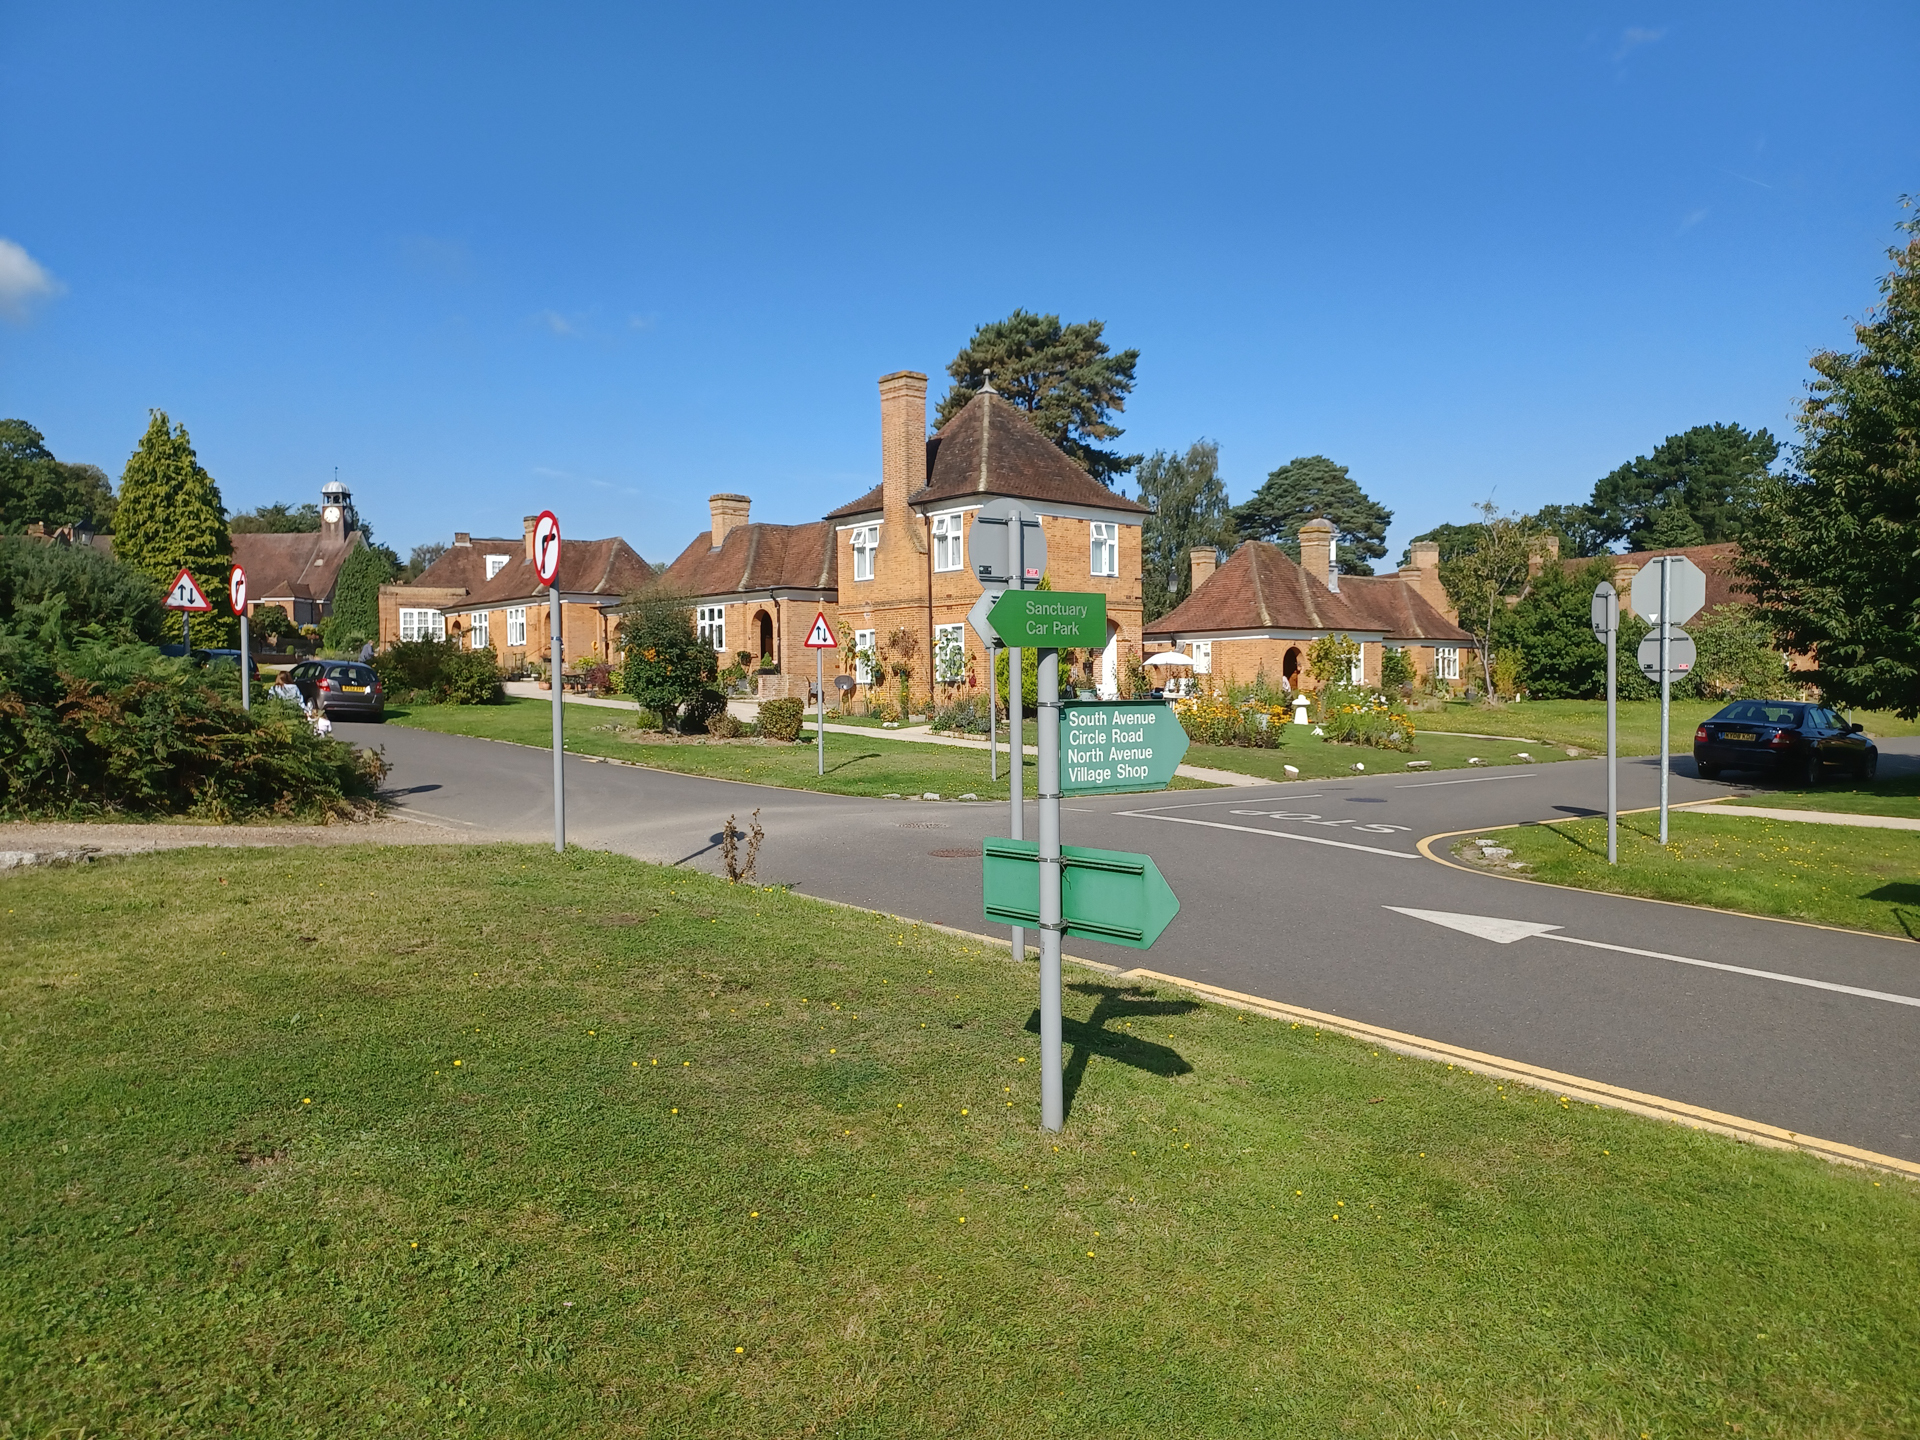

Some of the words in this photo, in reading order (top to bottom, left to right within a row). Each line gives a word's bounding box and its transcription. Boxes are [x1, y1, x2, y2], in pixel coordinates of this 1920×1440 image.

[1026, 600, 1088, 618] Sanctuary
[1026, 620, 1048, 635] Car
[1053, 621, 1080, 635] Park
[1069, 711, 1107, 727] South
[1112, 710, 1156, 725] Avenue
[1069, 730, 1107, 746] Circle
[1112, 727, 1144, 743] Road
[1068, 747, 1104, 764] North
[1109, 746, 1153, 761] Avenue
[1068, 766, 1112, 784] Village
[1117, 763, 1149, 780] Shop
[1229, 809, 1412, 834] STOP
